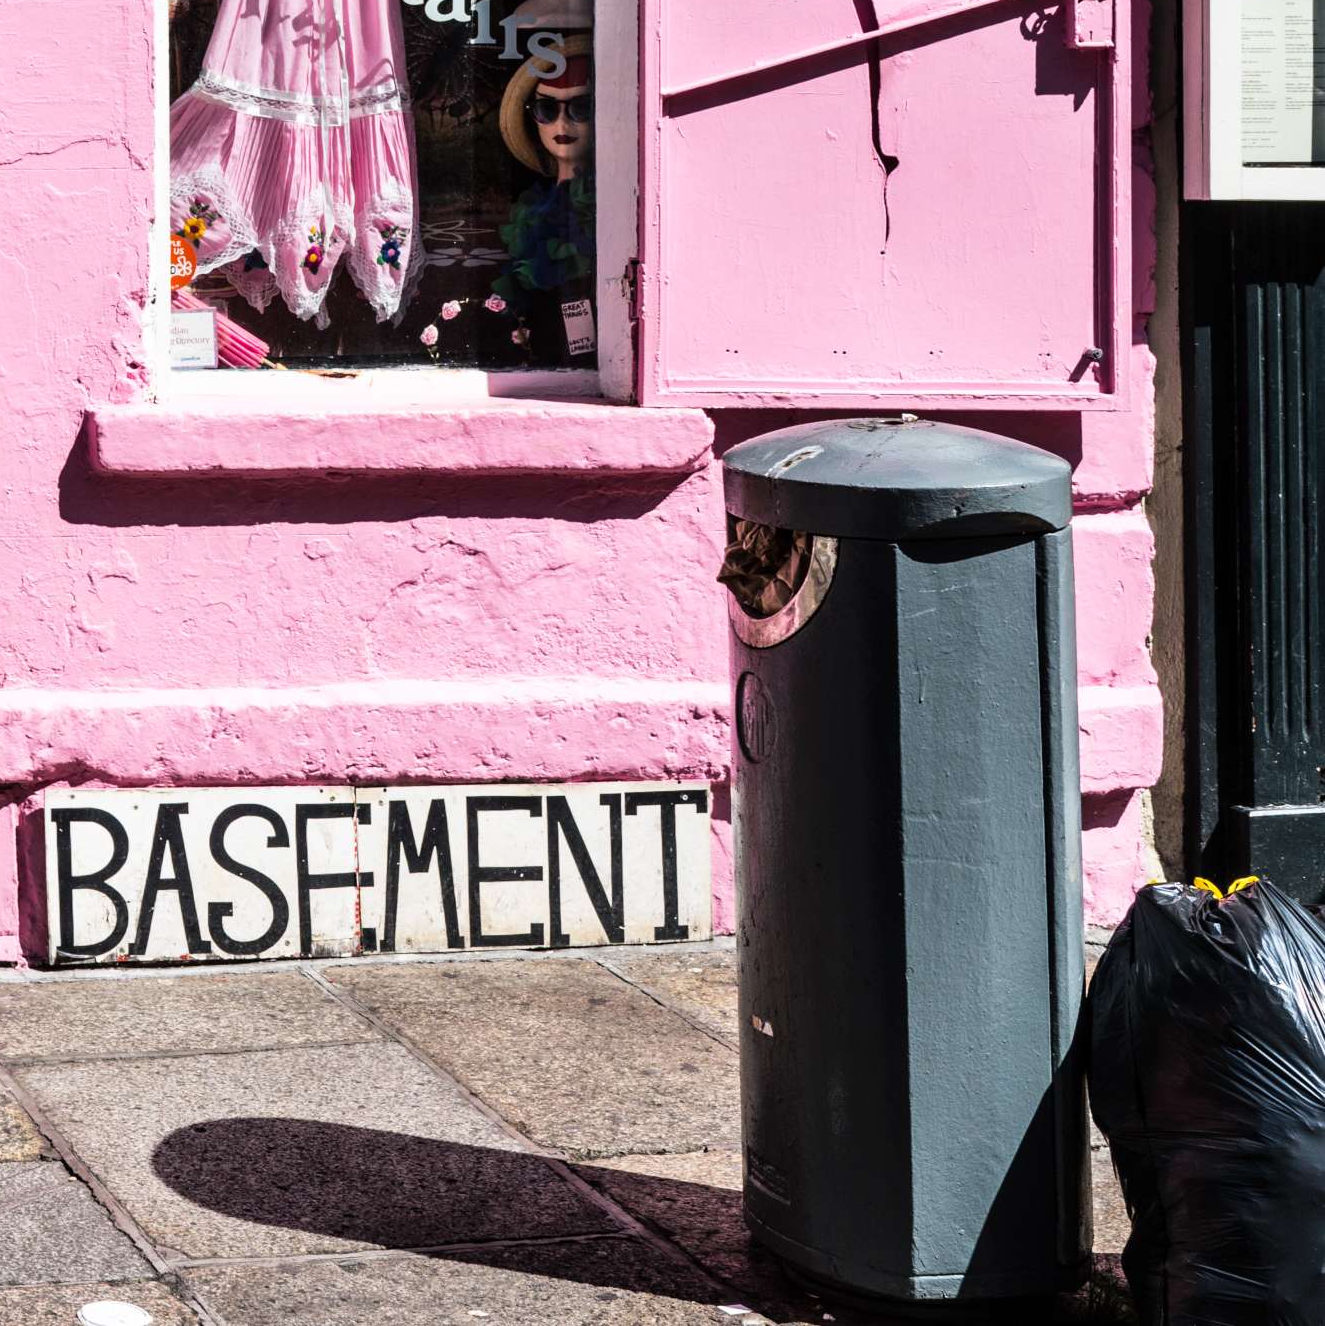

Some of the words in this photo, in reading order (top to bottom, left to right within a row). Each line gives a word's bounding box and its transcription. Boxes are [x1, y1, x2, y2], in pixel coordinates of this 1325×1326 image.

[563, 300, 585, 312] GREAT
[176, 337, 210, 345] Directory
[50, 789, 708, 957] BASEMENT
